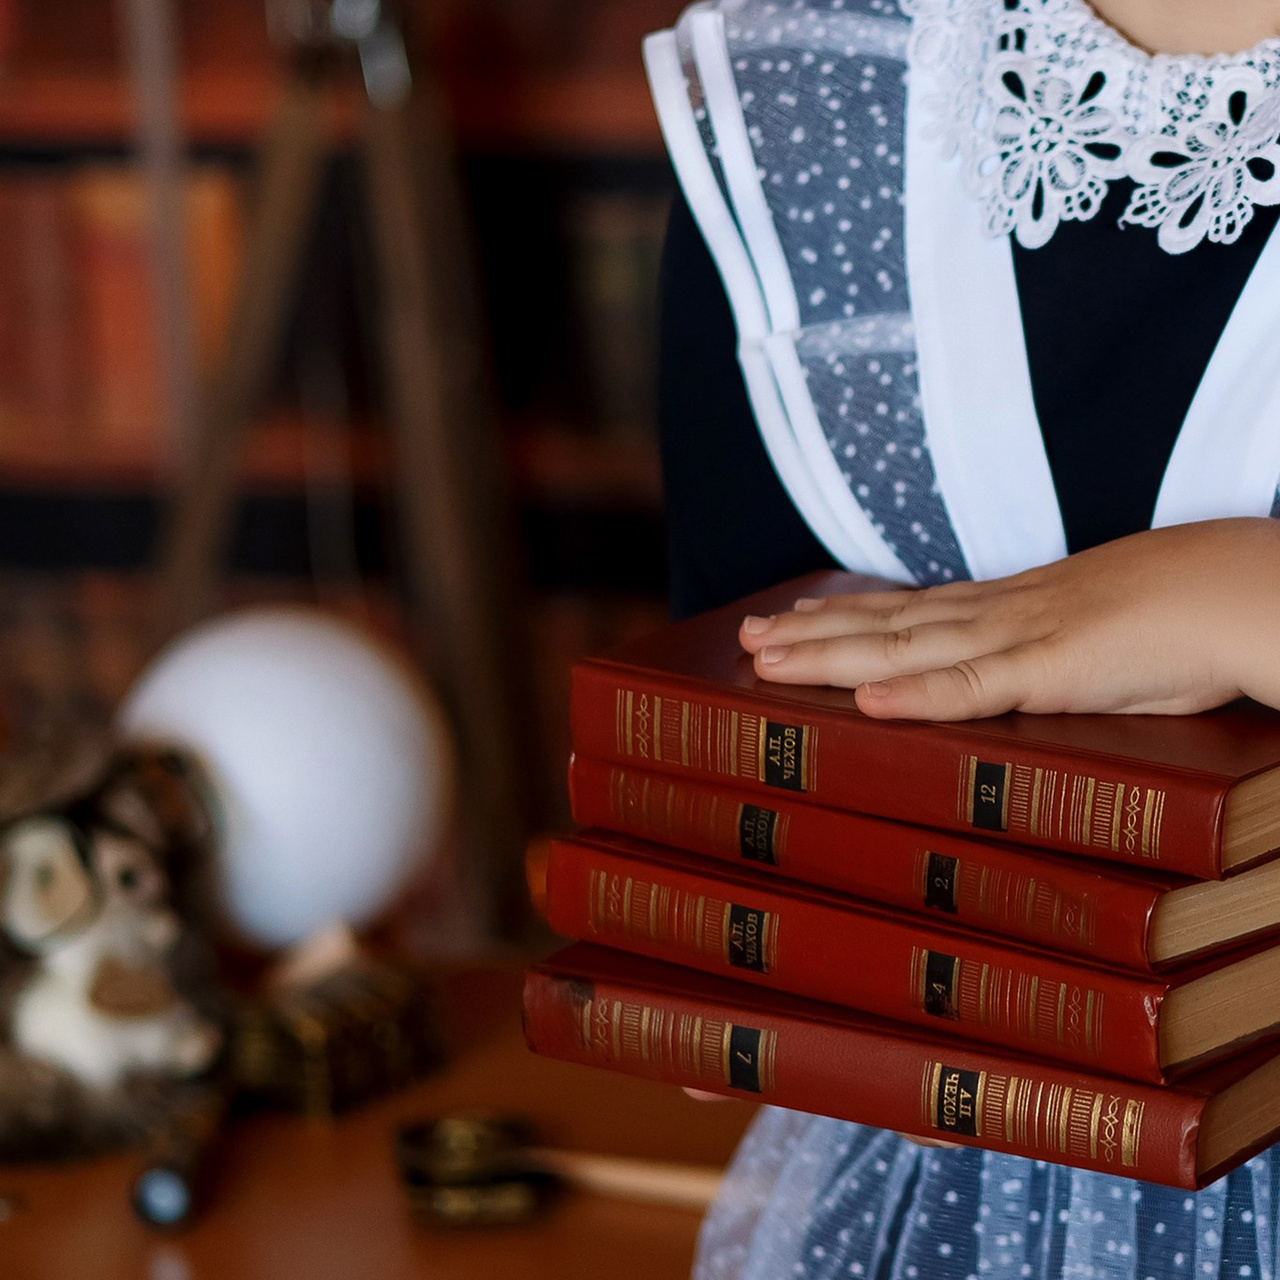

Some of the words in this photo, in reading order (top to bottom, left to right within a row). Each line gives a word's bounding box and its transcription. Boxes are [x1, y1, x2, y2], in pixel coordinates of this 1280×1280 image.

[783, 727, 797, 780] ЧЕХОВ
[980, 784, 996, 804] 12
[935, 877, 949, 890] 2
[744, 913, 758, 963] ЧЕХОВ
[932, 983, 946, 994] 4
[736, 1051, 752, 1065] 7
[943, 1073, 959, 1126] ЧЕХОВ
